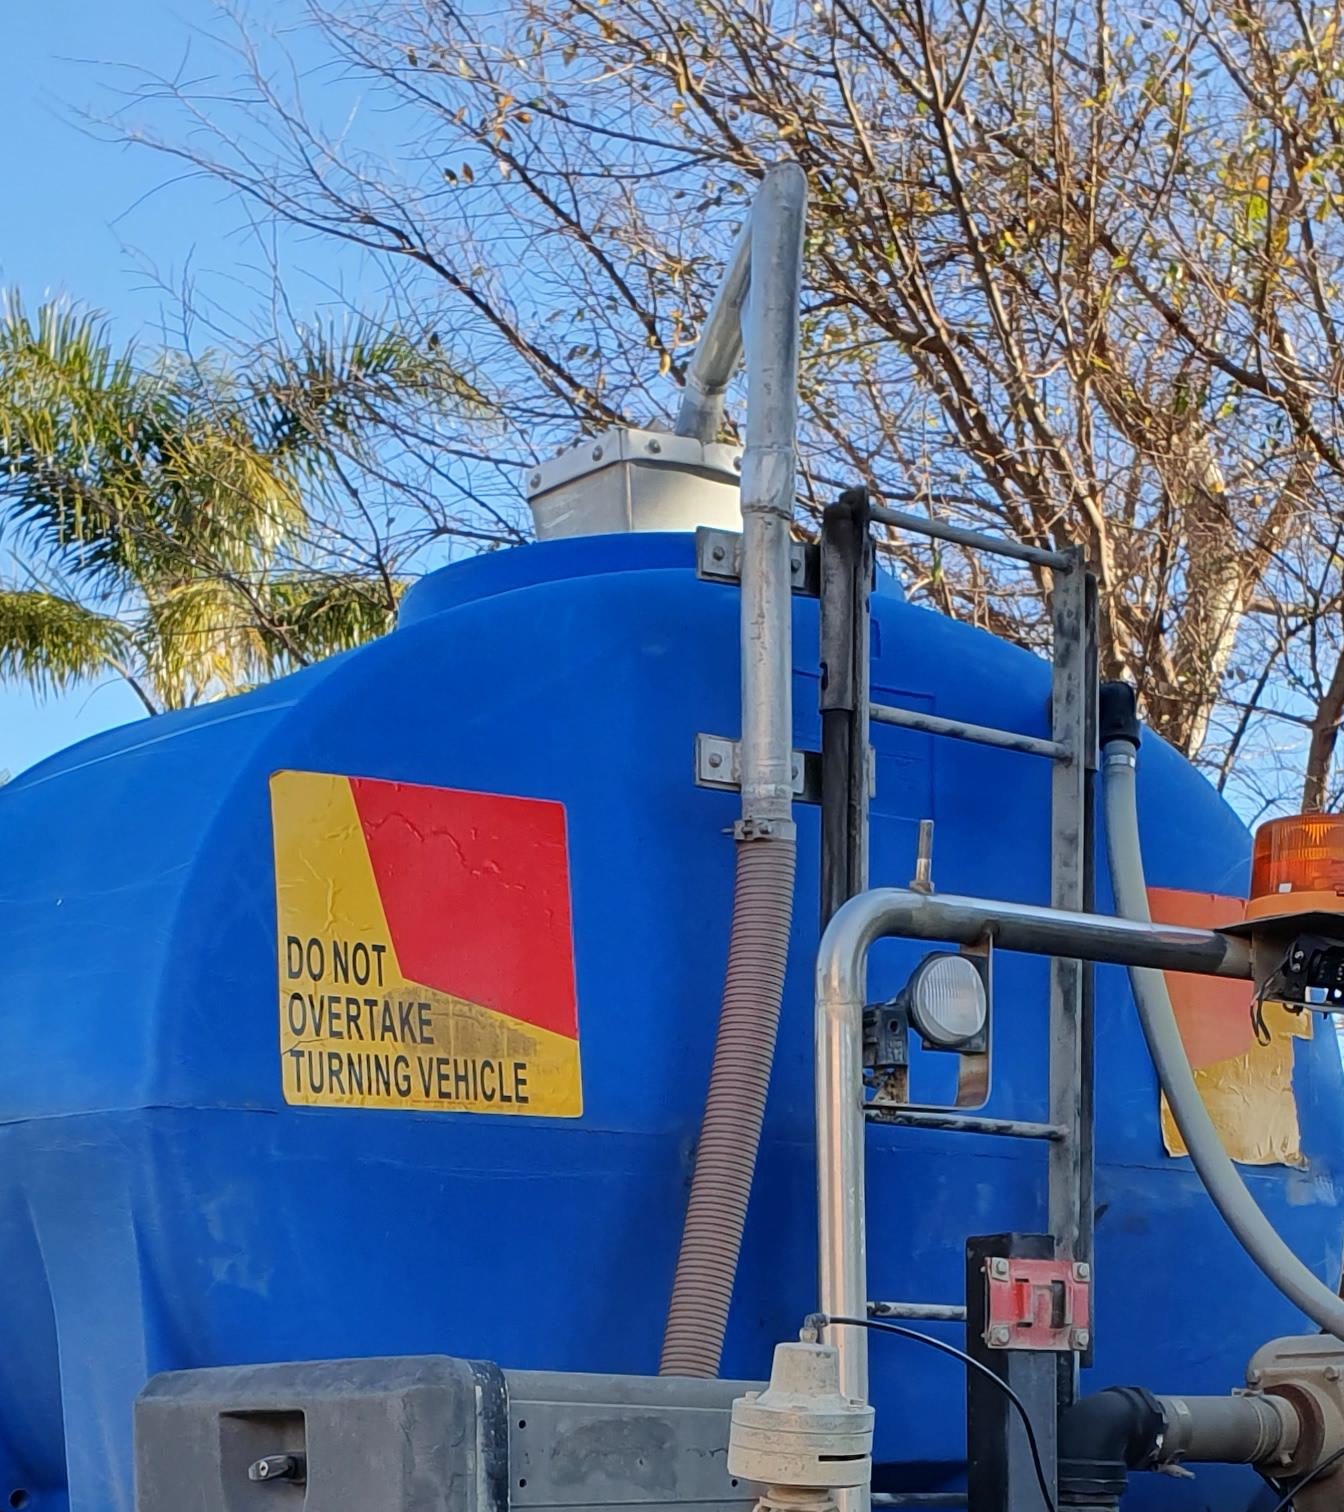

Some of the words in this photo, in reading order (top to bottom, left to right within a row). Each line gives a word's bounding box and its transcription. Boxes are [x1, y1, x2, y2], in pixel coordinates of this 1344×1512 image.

[286, 935, 325, 982] DO
[332, 940, 387, 988] NOT
[288, 992, 435, 1045] OVERTAKE
[290, 1050, 411, 1099] TURNING
[417, 1056, 530, 1104] VEHICLE
